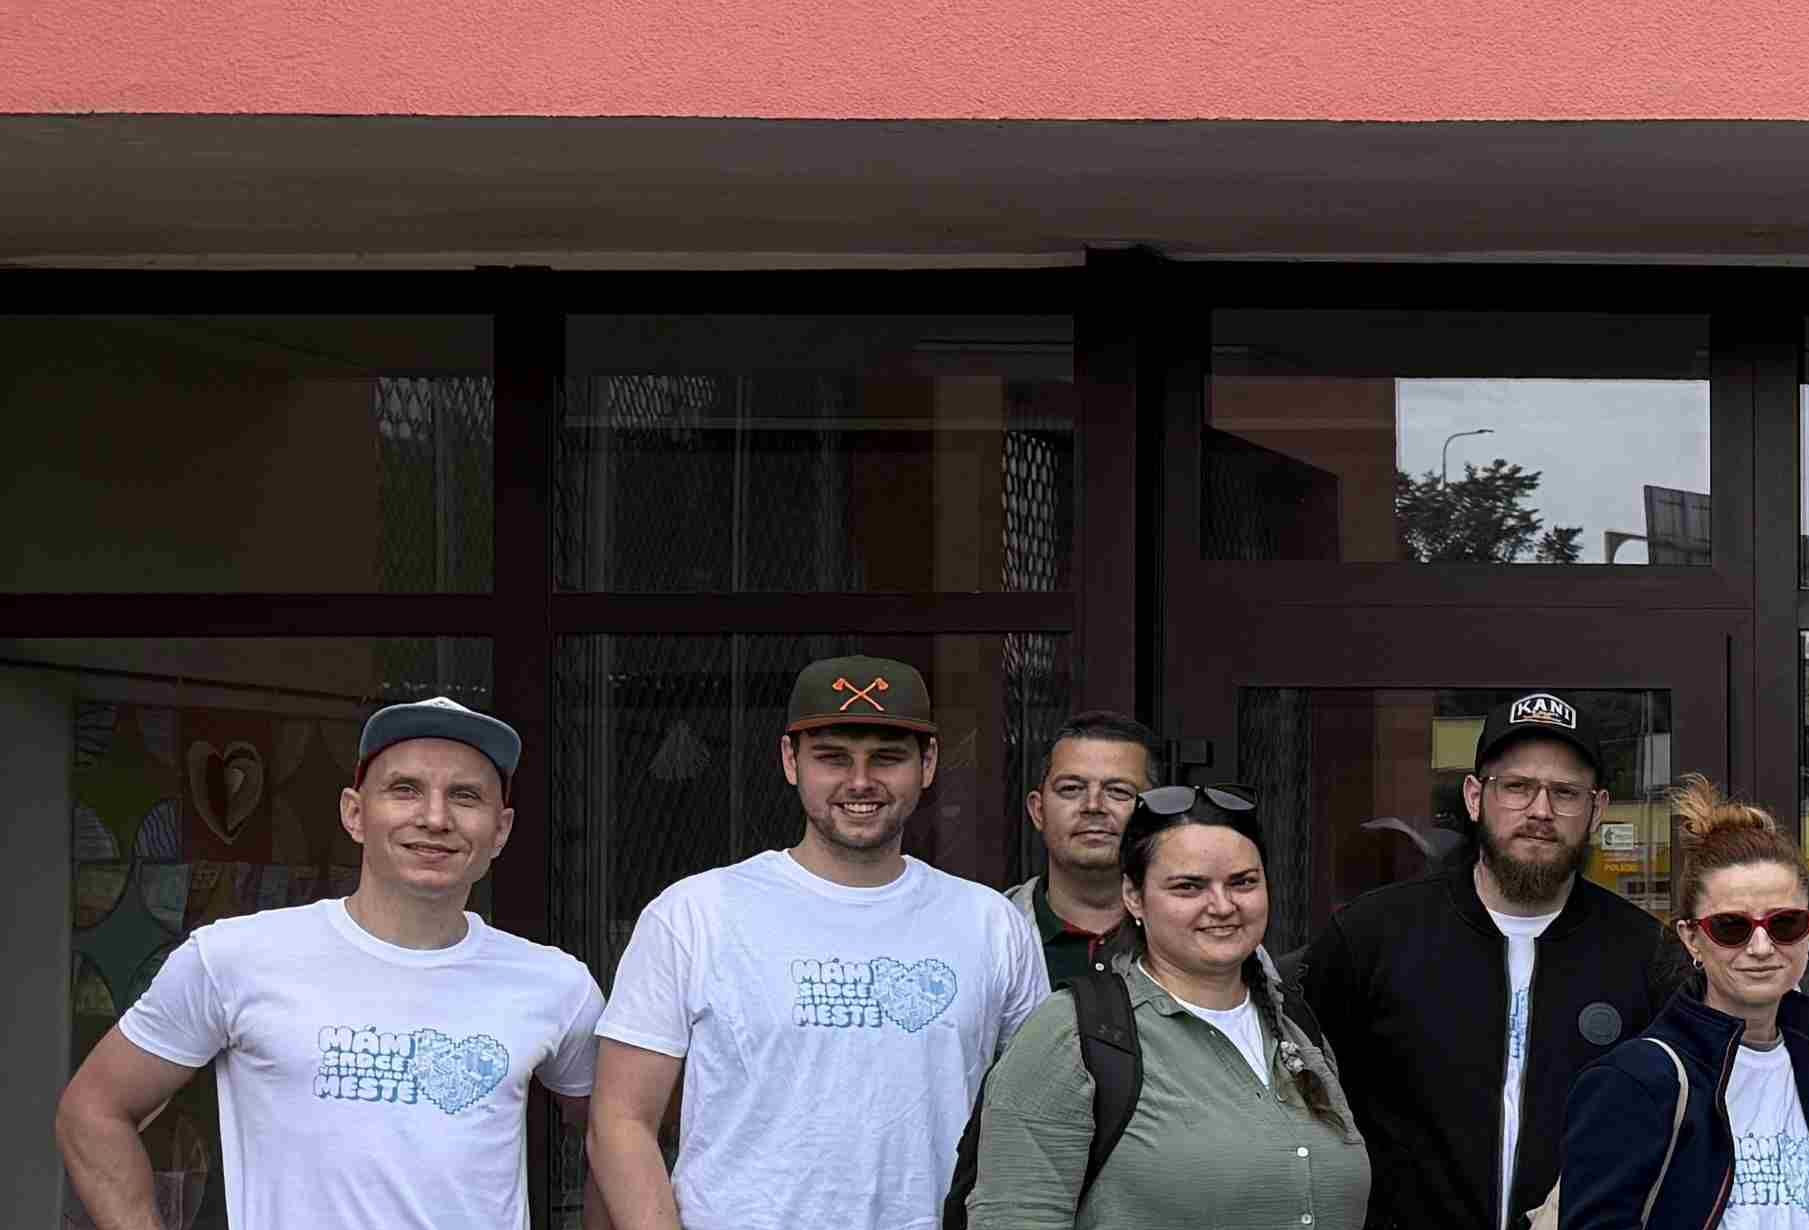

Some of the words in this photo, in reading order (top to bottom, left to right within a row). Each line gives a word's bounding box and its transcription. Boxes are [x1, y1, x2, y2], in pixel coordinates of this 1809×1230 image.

[792, 958, 874, 984] MÁM
[792, 1003, 882, 1027] MESTE
[319, 1023, 416, 1059] MÁM
[323, 1050, 409, 1073] SRDCE
[313, 1074, 418, 1104] MESTE
